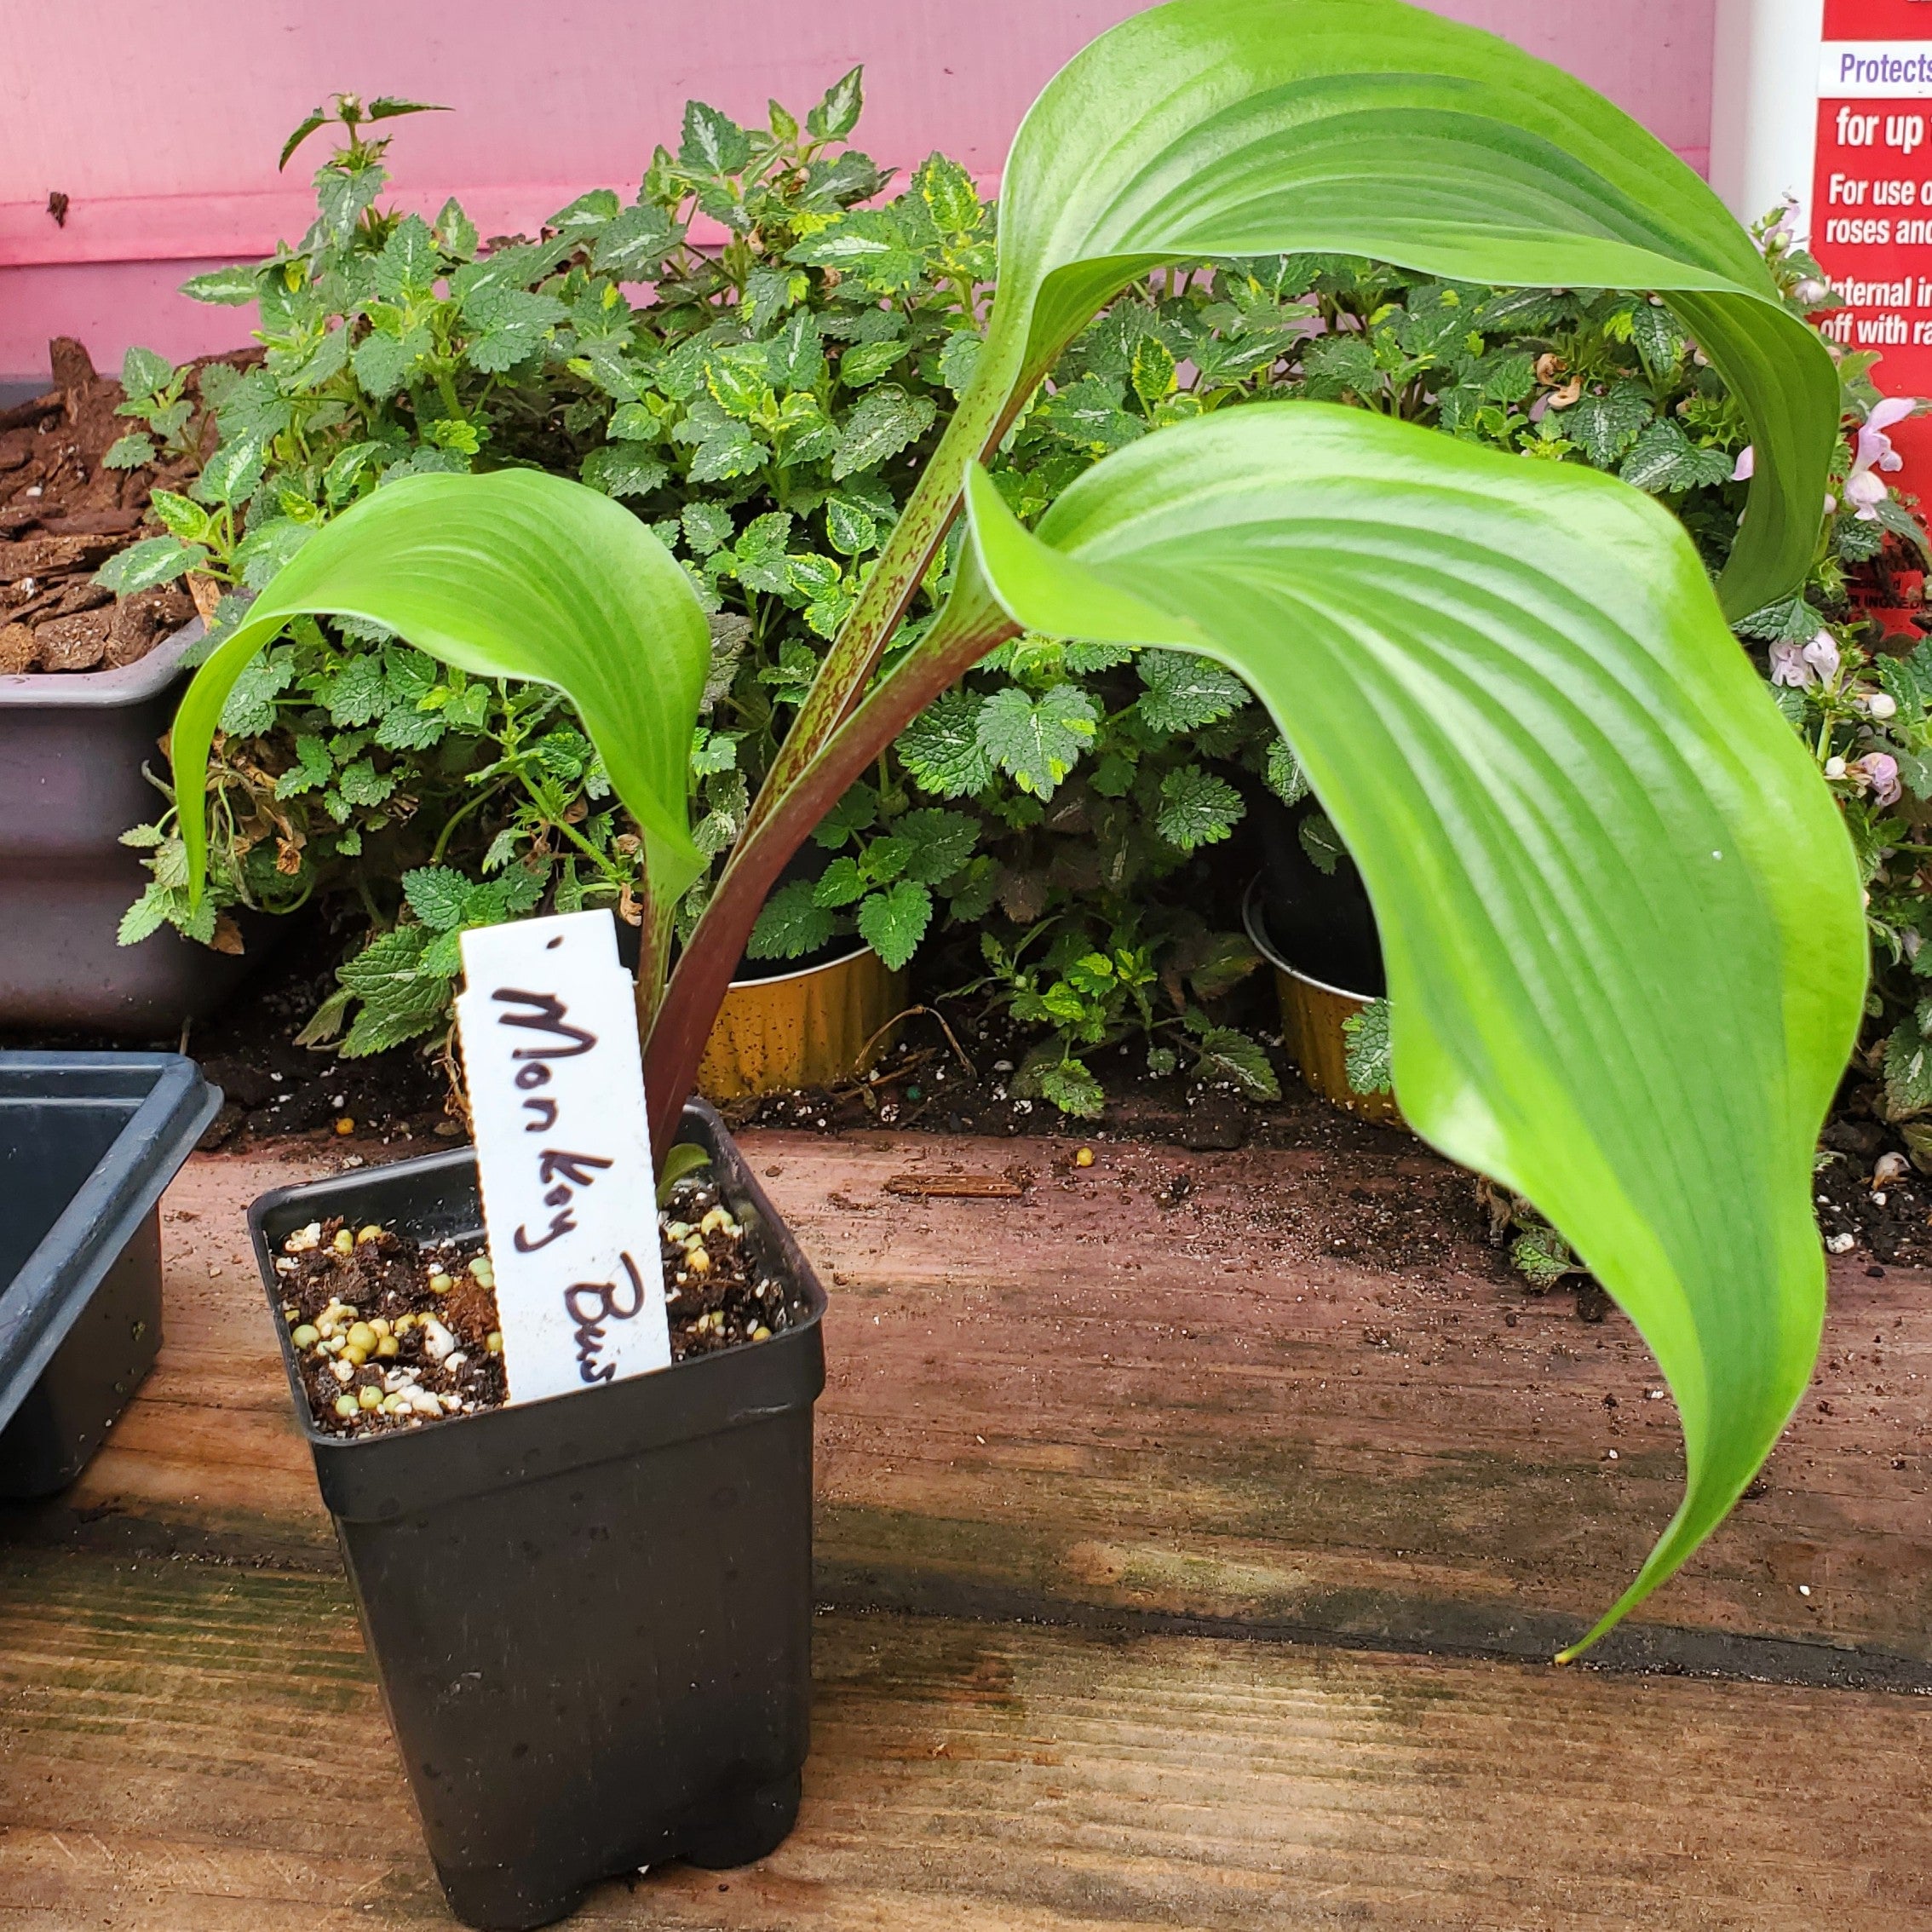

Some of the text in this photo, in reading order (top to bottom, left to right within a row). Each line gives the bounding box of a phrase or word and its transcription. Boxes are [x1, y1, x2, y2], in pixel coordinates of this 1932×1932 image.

[1840, 53, 1932, 83] Protects
[1836, 105, 1880, 147] for
[1885, 115, 1924, 155] up
[1828, 173, 1869, 205] For
[1872, 180, 1916, 206] use
[1826, 218, 1890, 244] roses
[1820, 313, 1854, 343] off
[1856, 313, 1908, 345] with
